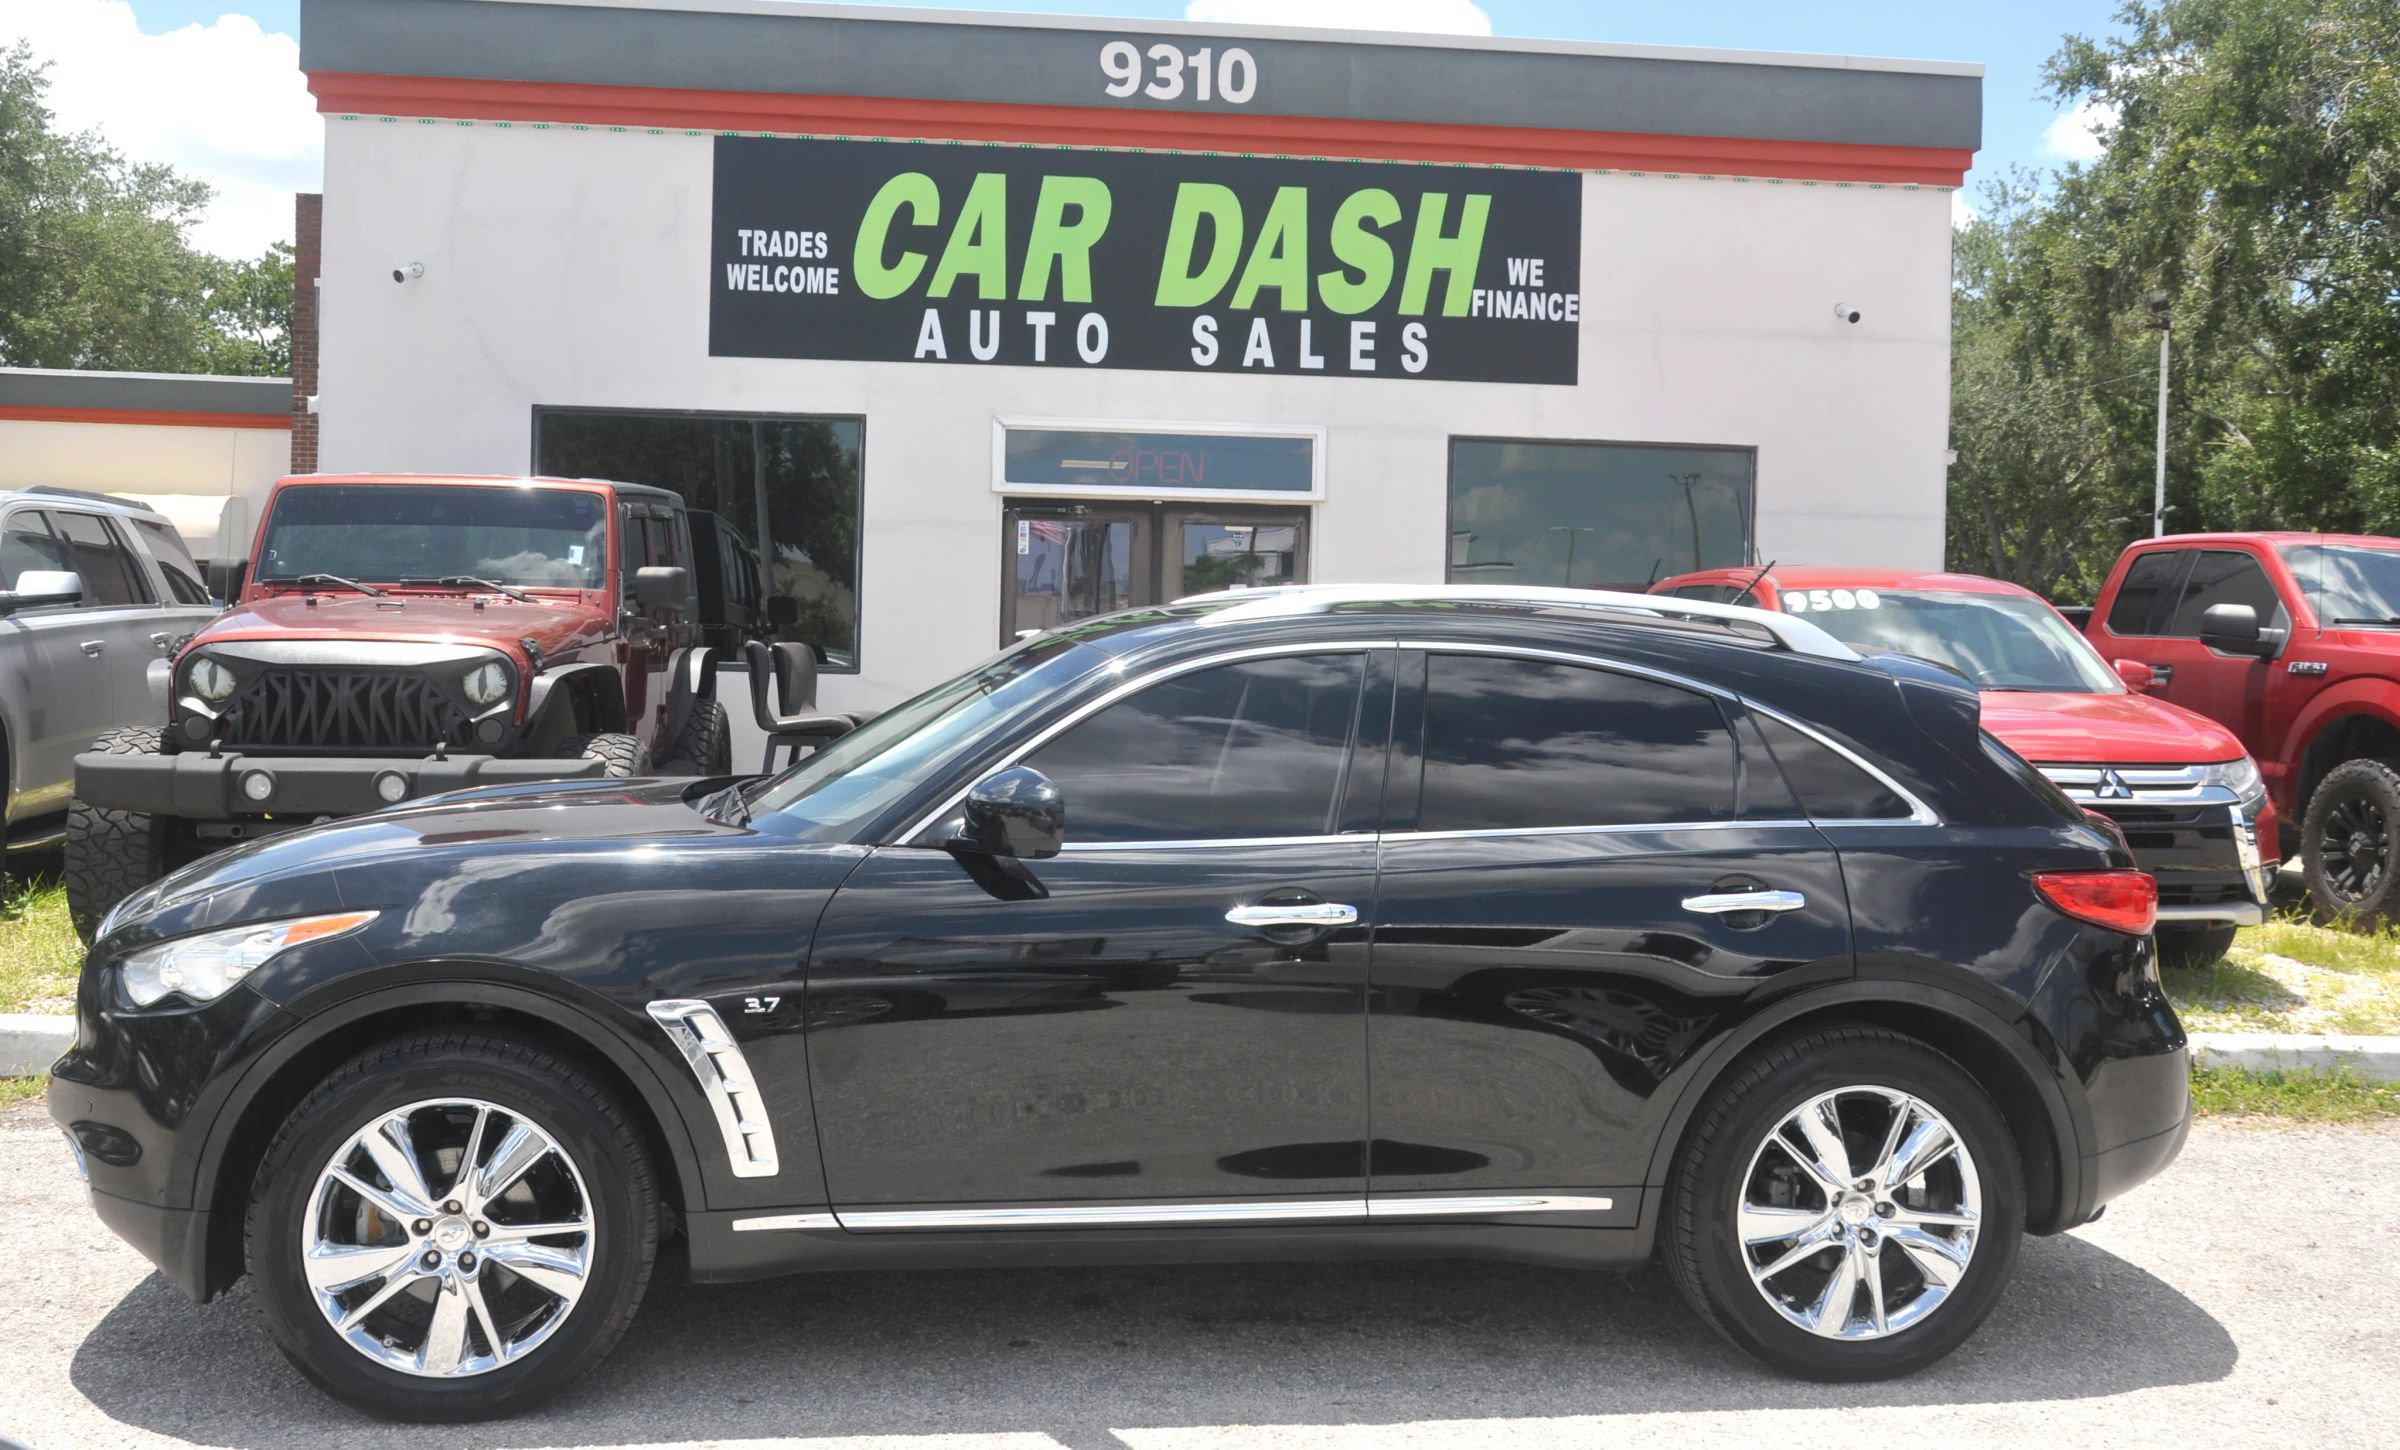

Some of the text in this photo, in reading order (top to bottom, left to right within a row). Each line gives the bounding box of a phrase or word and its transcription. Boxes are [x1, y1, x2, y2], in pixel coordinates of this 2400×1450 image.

[1100, 41, 1257, 104] 9310
[738, 229, 828, 259] TRADES
[853, 172, 1492, 317] CAR DASH
[727, 263, 839, 295] WELCOME
[1507, 257, 1544, 287] WE
[1472, 288, 1579, 322] FINANCE
[914, 308, 1429, 373] AUTO SALES
[1109, 448, 1206, 483] OPEN
[1783, 588, 1881, 613] 9500
